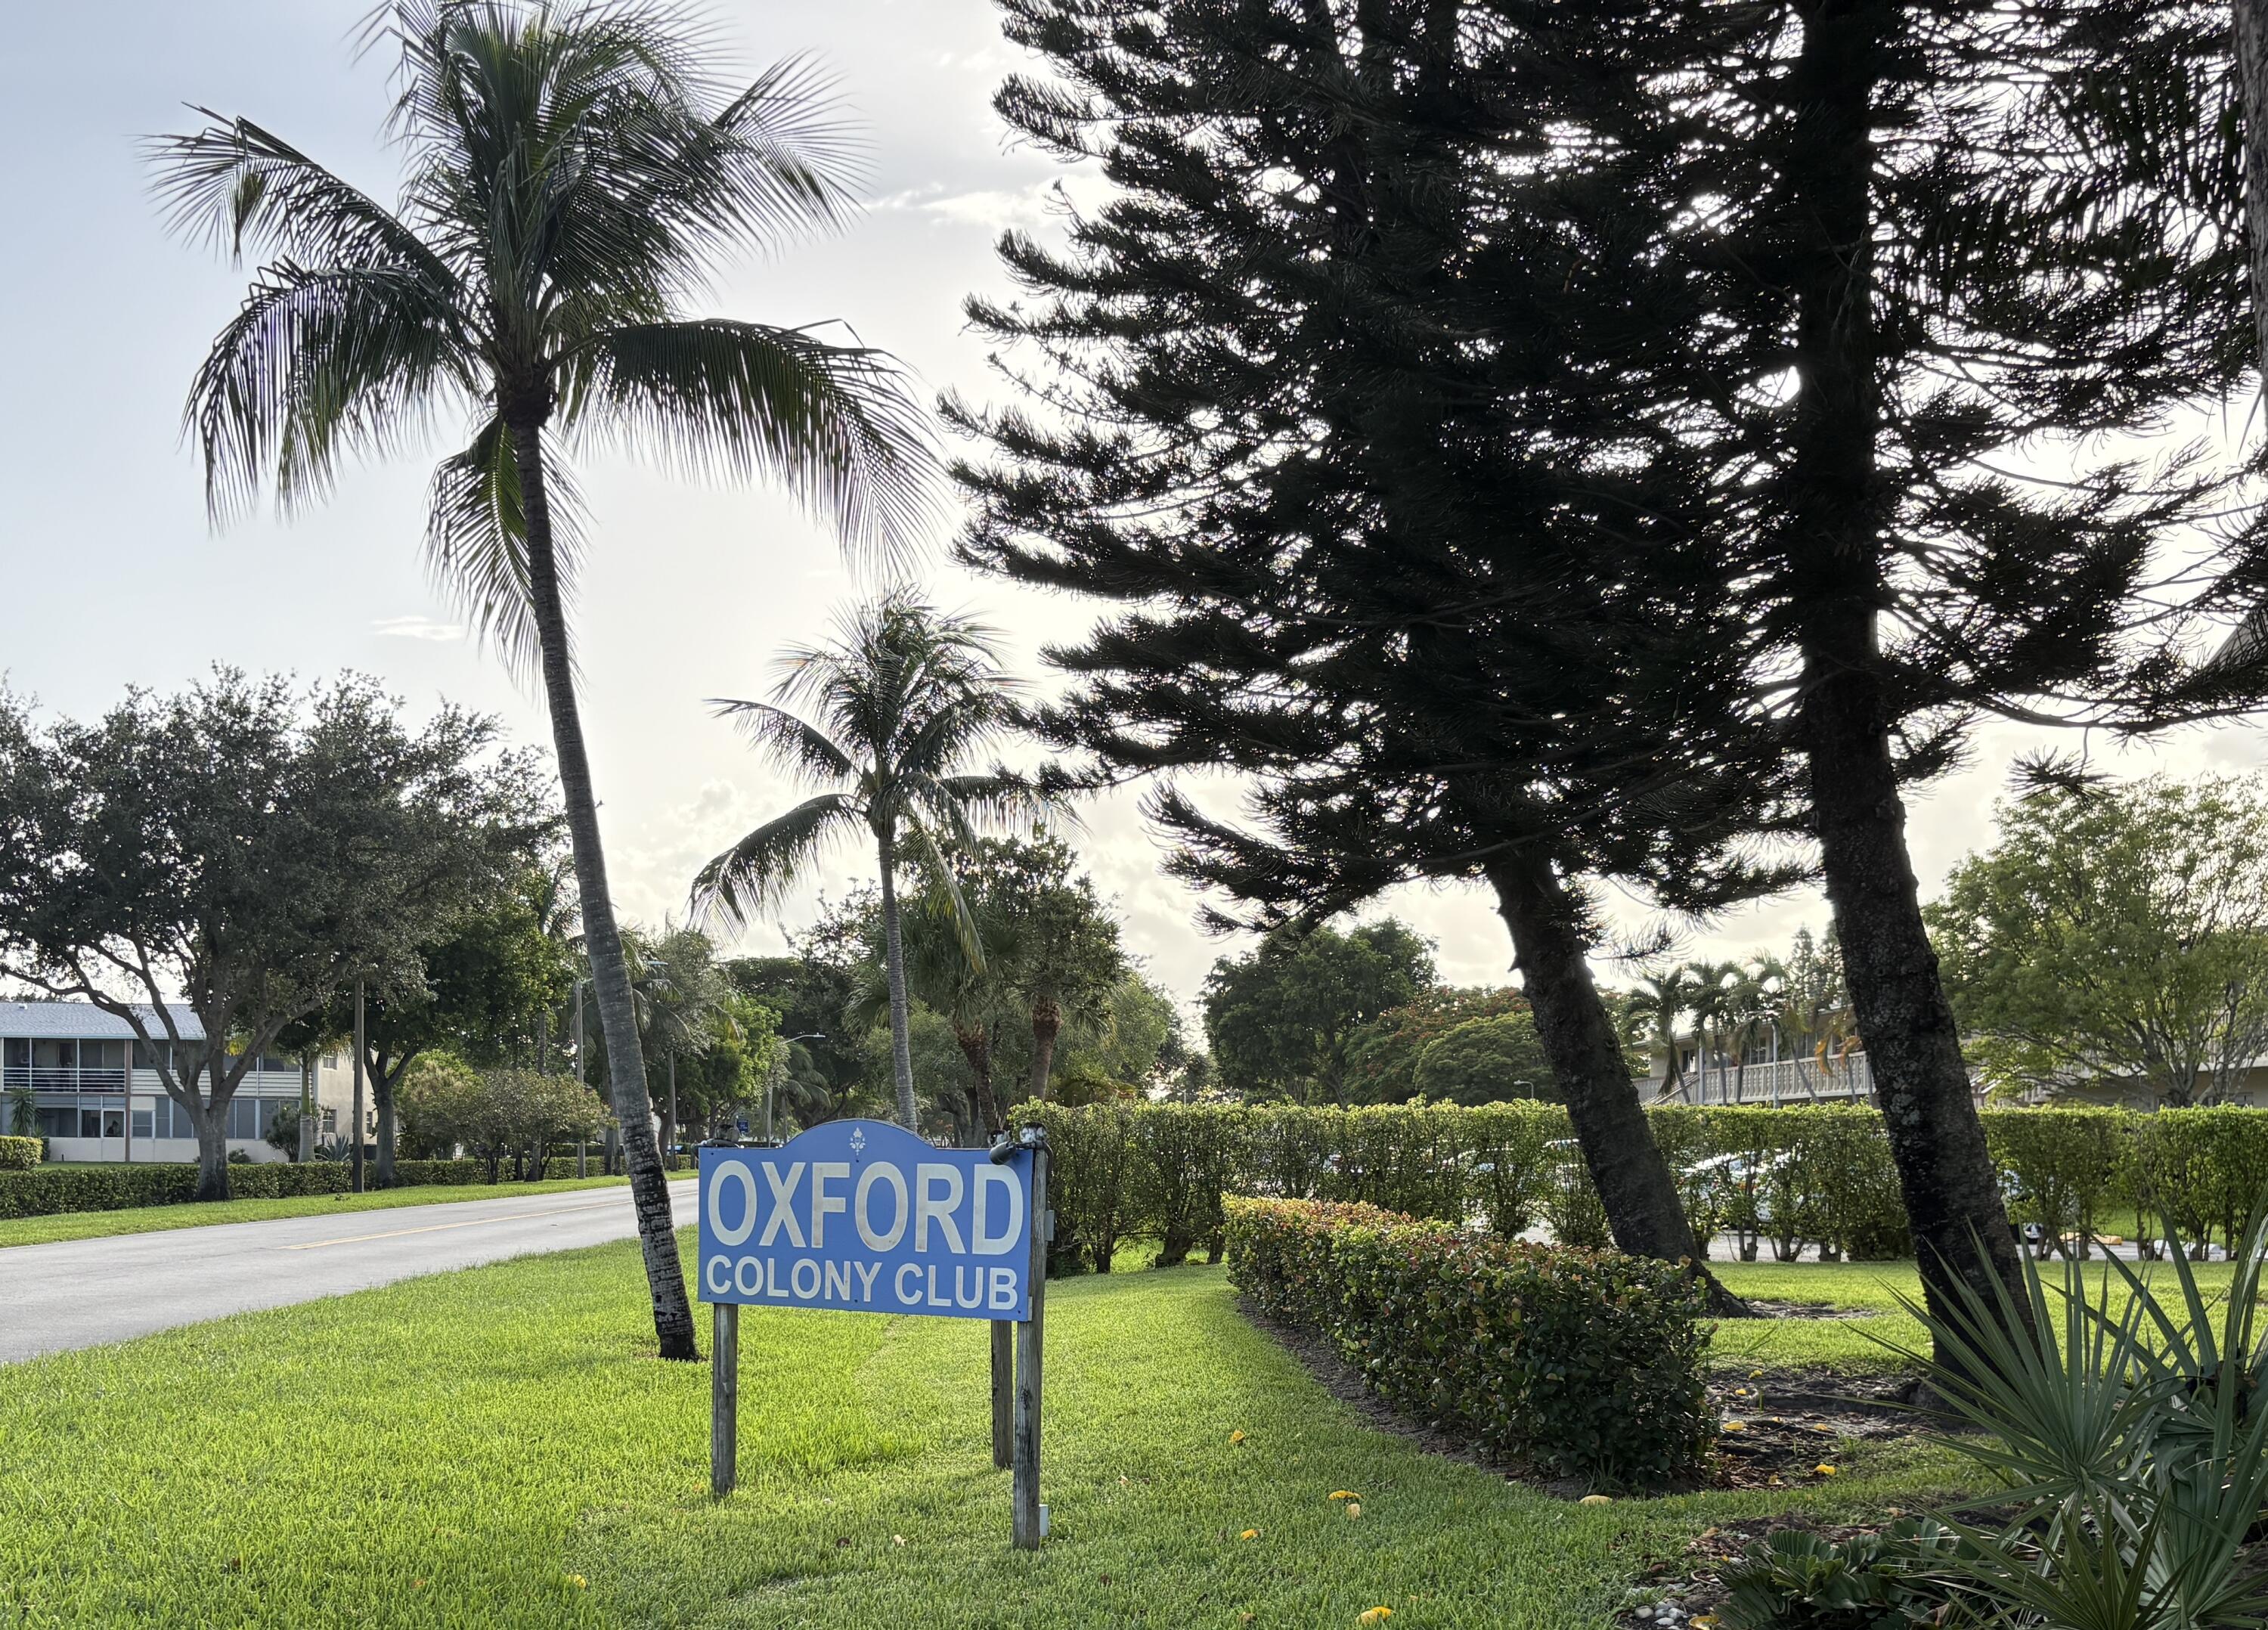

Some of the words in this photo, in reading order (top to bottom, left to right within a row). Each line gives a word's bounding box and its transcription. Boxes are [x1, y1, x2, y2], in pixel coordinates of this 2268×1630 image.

[708, 1160, 1024, 1255] OXFORD
[706, 1254, 883, 1302] COLONY
[894, 1263, 1018, 1310] CLUB
